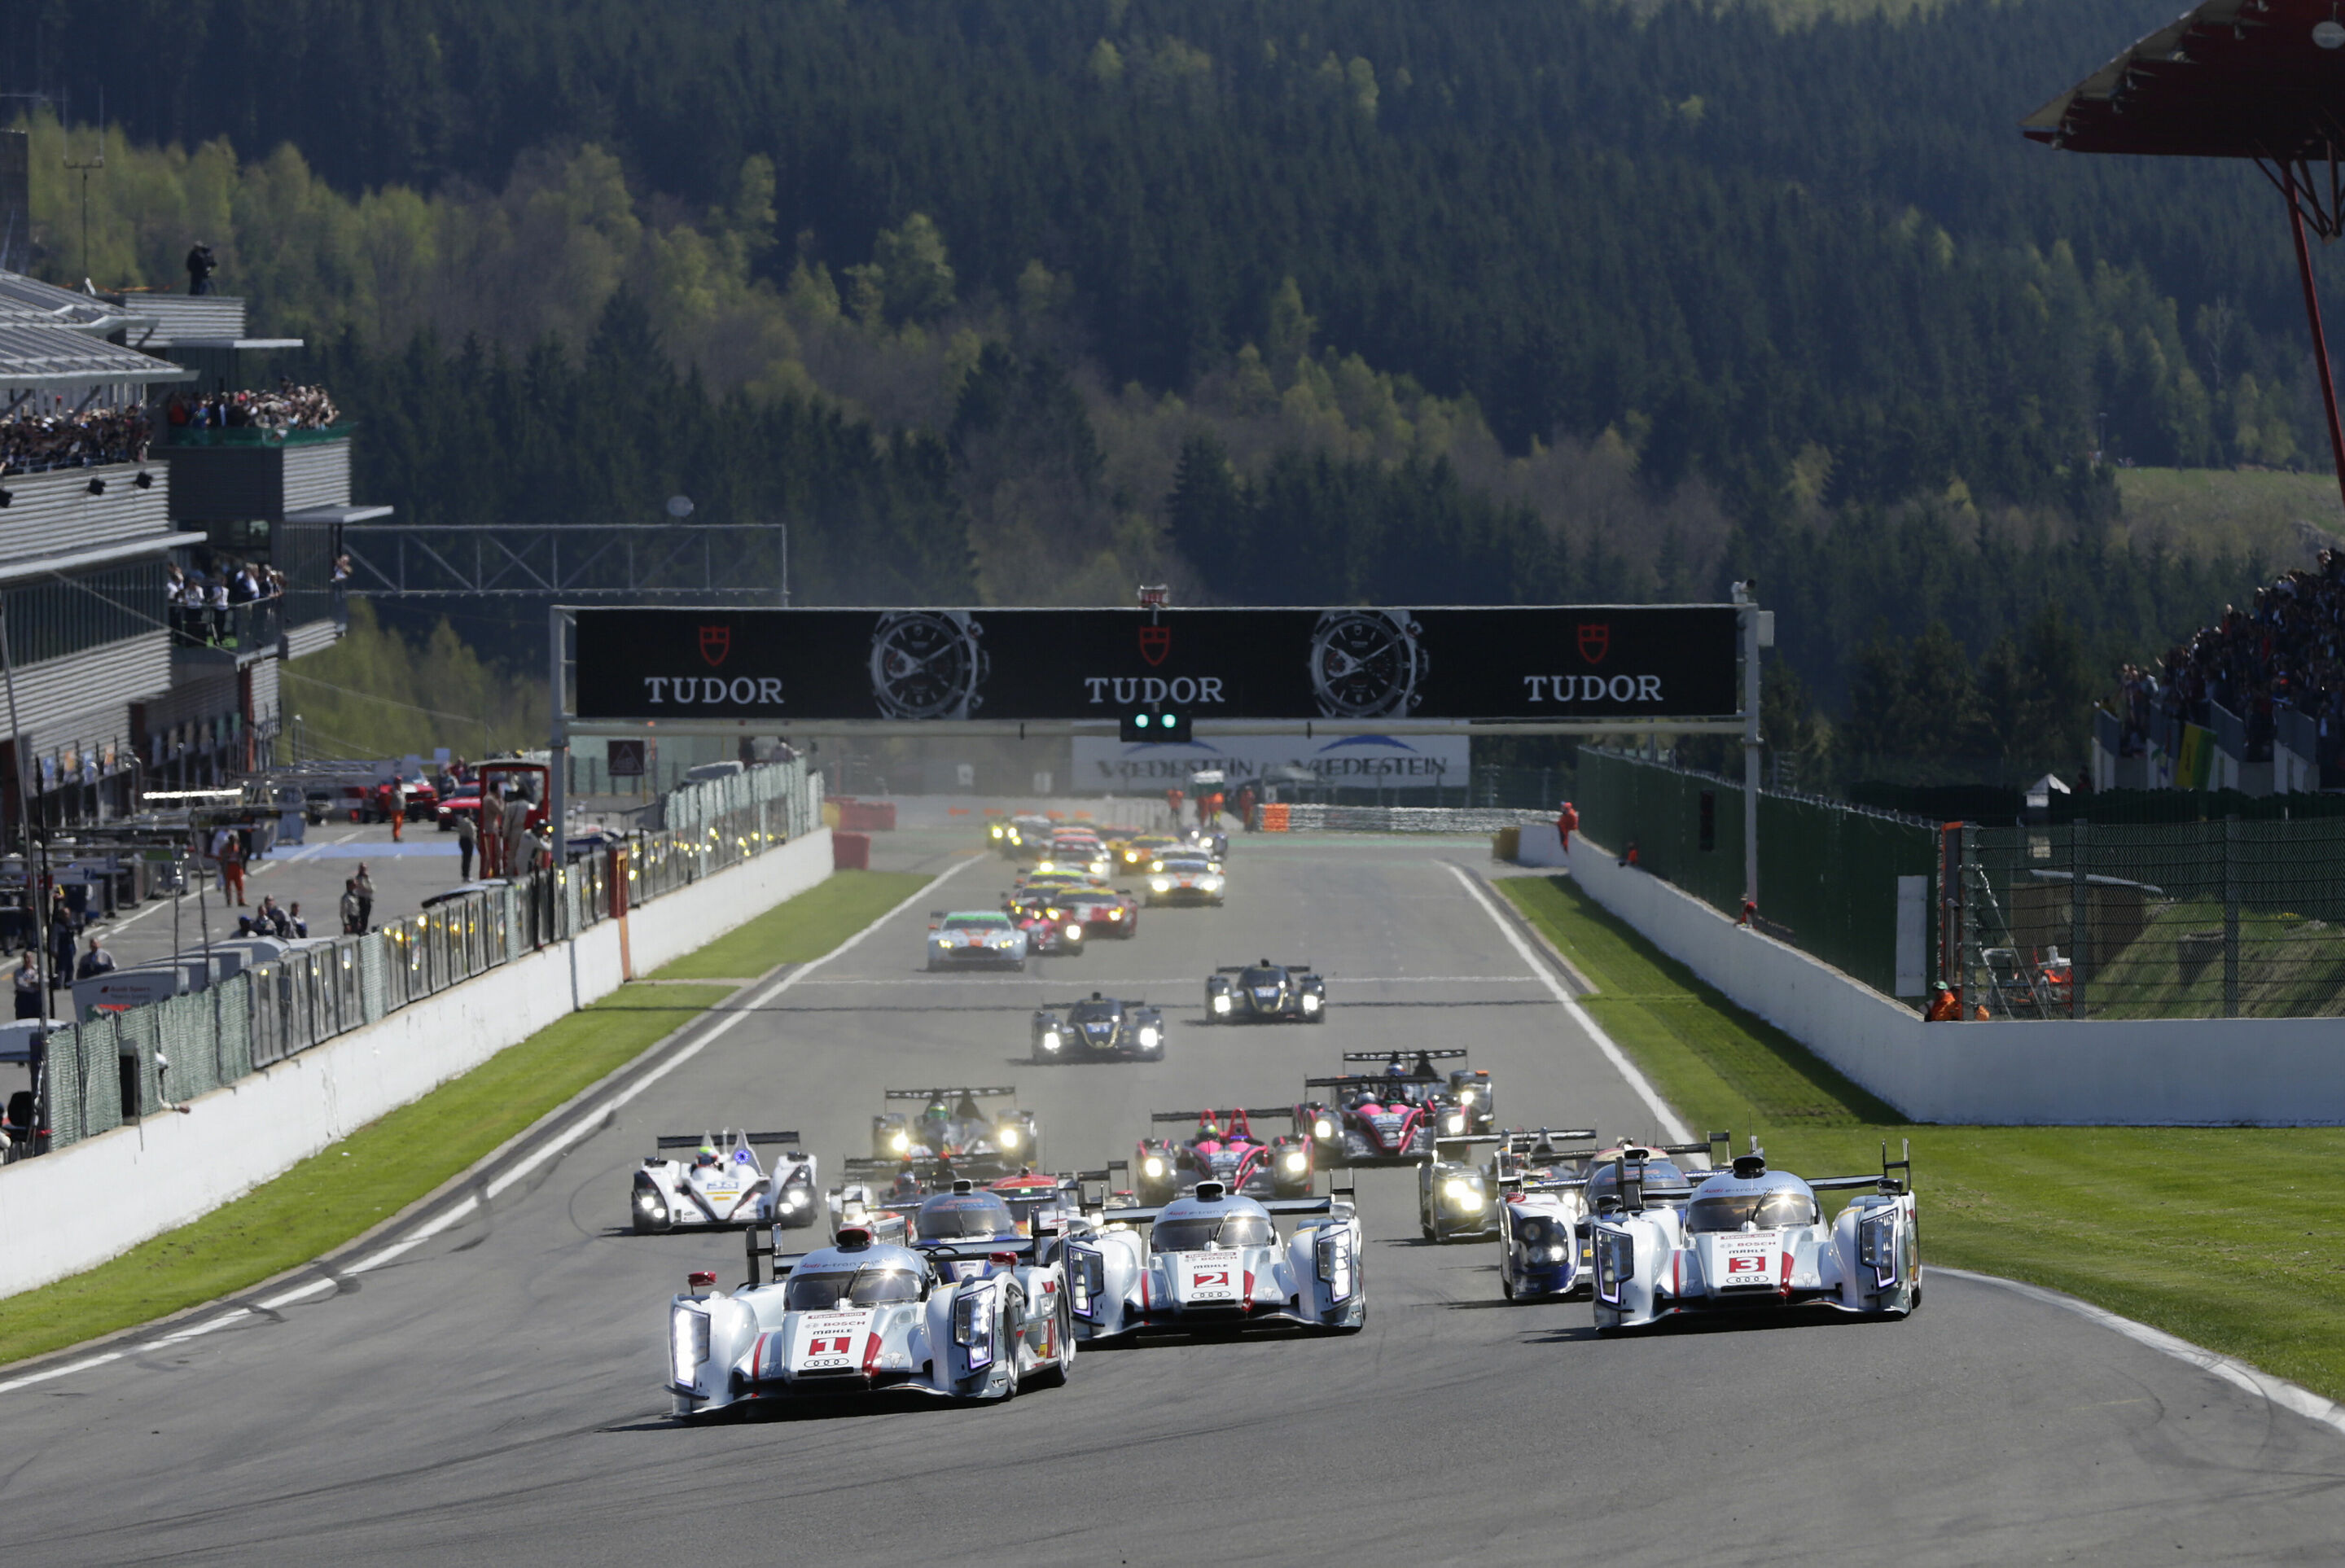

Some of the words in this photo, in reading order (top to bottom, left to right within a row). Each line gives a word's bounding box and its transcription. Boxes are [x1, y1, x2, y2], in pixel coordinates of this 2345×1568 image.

[644, 677, 784, 704] TUDOR
[1085, 677, 1225, 704] TUDOR
[1523, 675, 1663, 703] TUDOR
[1734, 1257, 1760, 1272] 3
[1196, 1272, 1227, 1288] 2
[814, 1338, 842, 1356] 1
